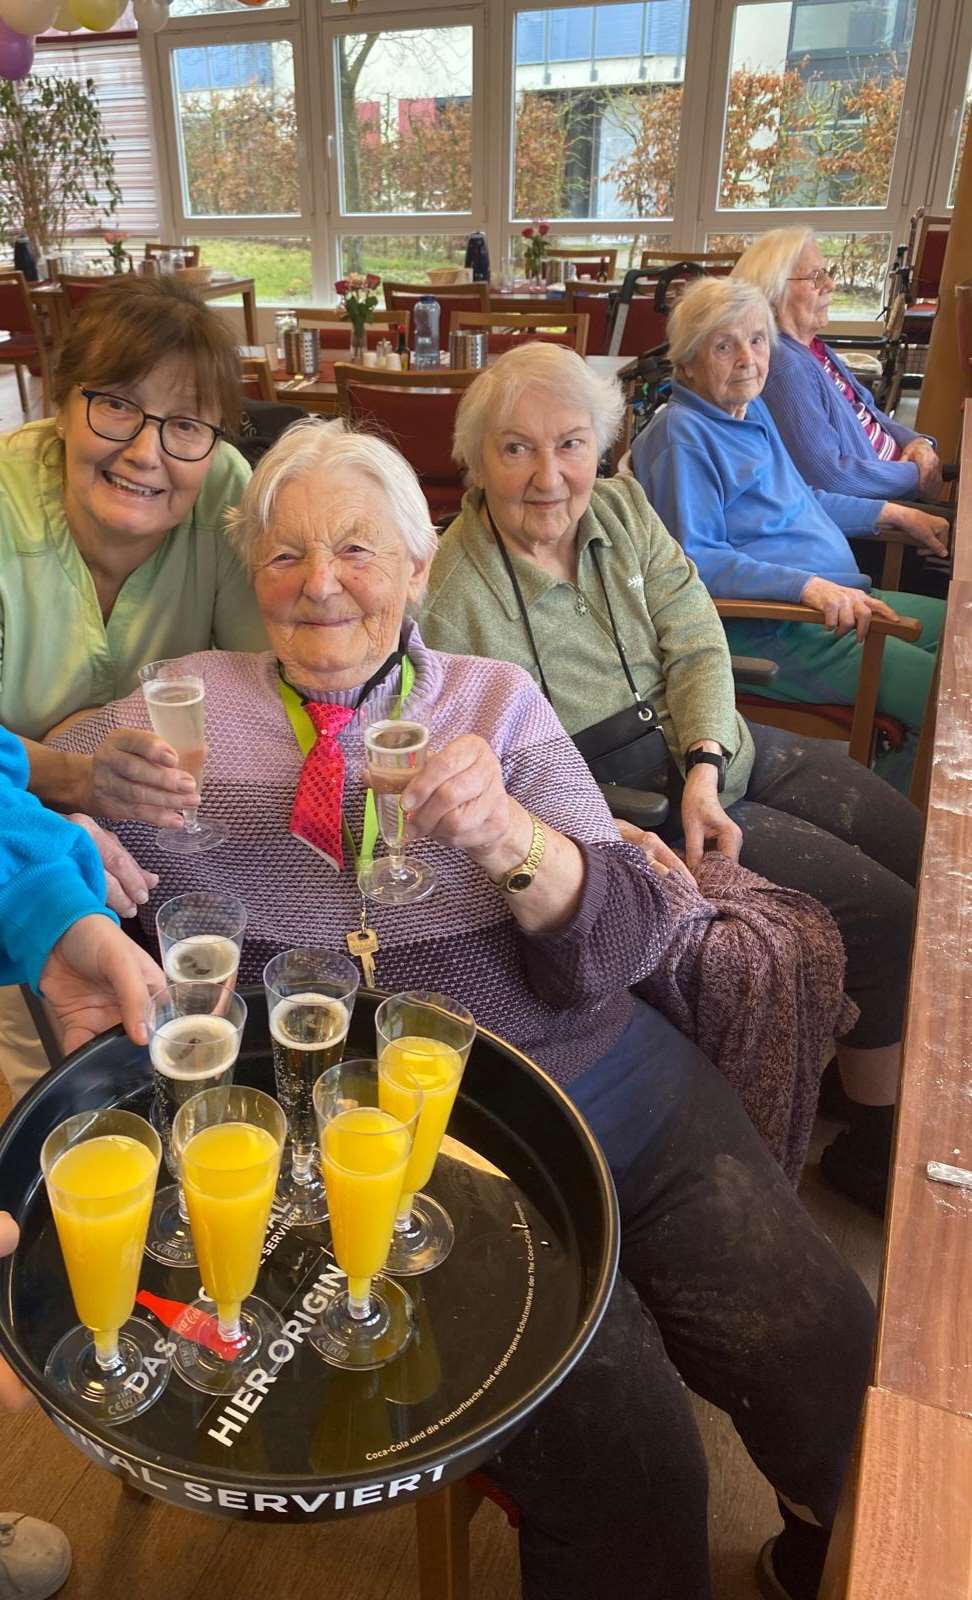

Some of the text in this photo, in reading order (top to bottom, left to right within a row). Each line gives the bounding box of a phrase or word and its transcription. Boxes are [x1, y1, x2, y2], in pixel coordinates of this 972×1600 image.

[527, 1262, 535, 1273] The
[527, 1275, 535, 1287] der
[516, 1287, 535, 1333] Schutzmarken
[123, 1337, 178, 1394] DAS
[208, 1367, 278, 1447] HIER
[268, 1263, 348, 1364] ORIGIN
[493, 1333, 522, 1376] eingetragene
[482, 1374, 497, 1390] sind
[438, 1388, 484, 1426] Konturflasche
[409, 1430, 427, 1444] und
[426, 1423, 440, 1435] die
[365, 1442, 410, 1461] Coca-Cola
[184, 1464, 446, 1513] SERVIERT
